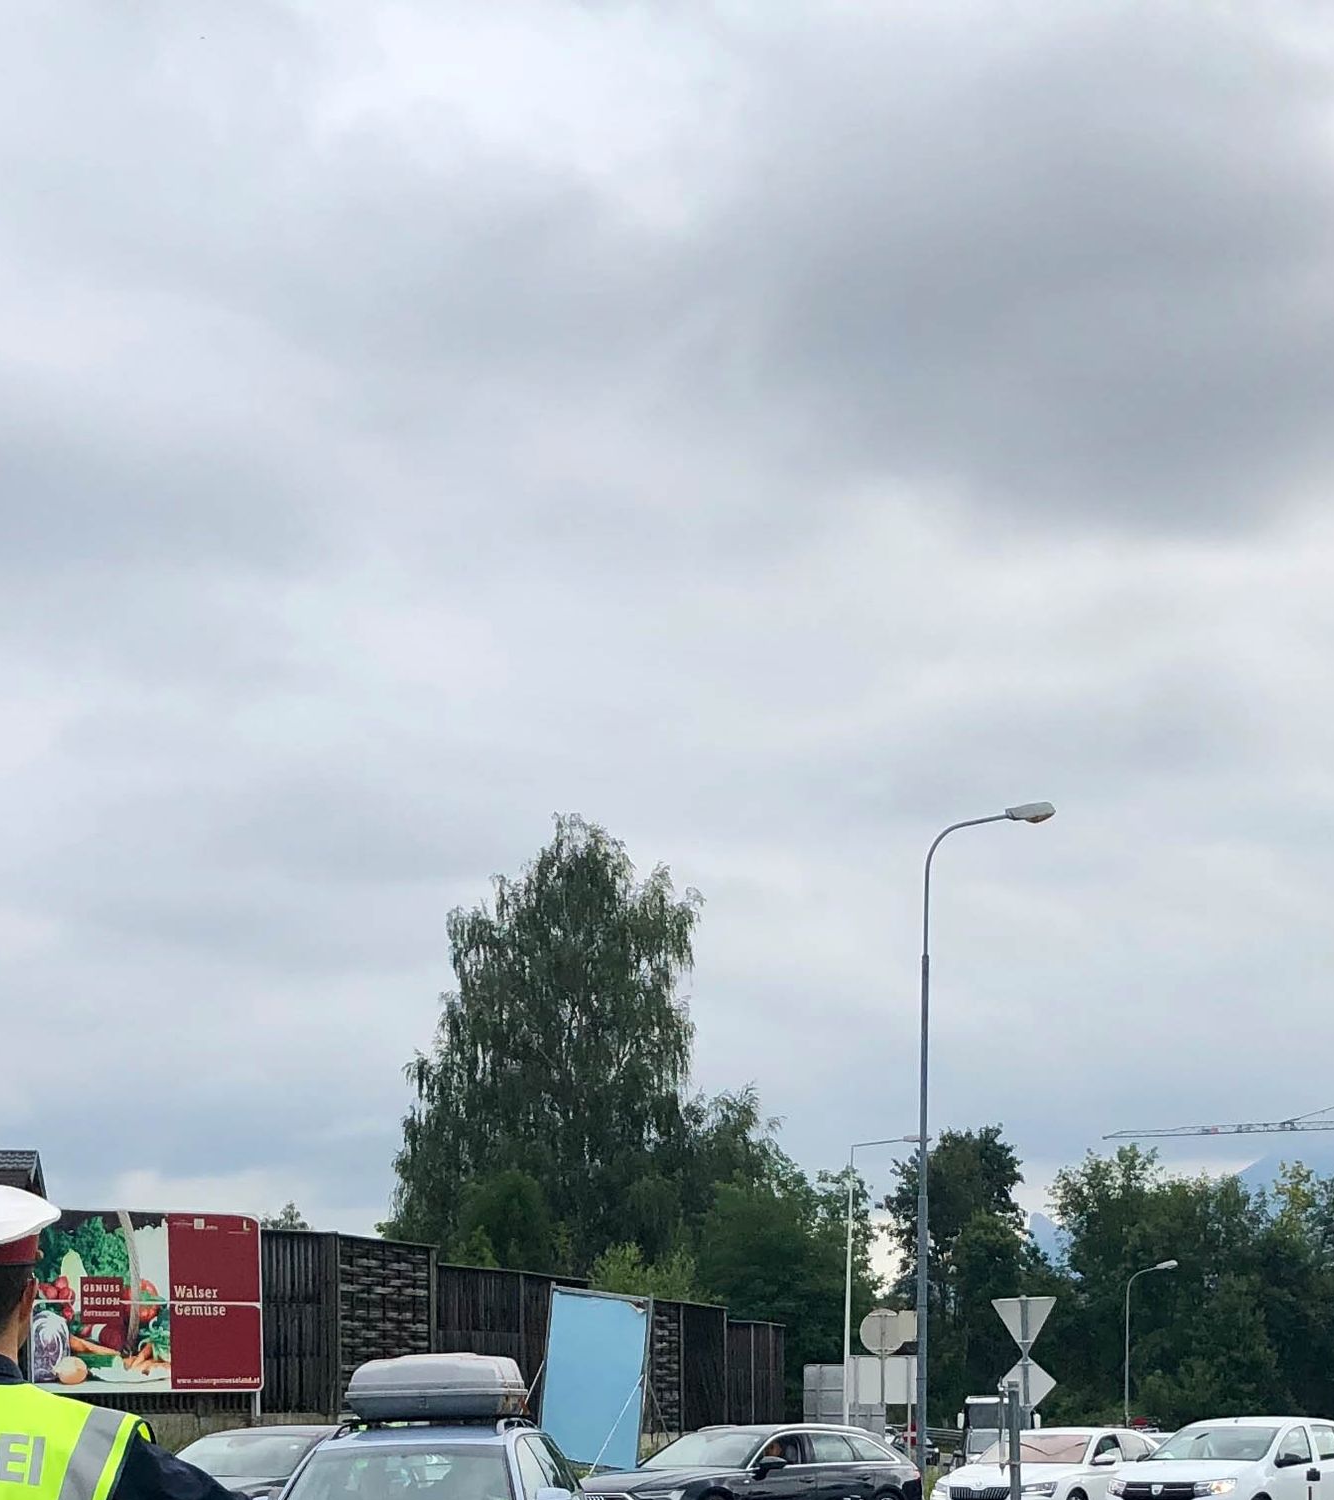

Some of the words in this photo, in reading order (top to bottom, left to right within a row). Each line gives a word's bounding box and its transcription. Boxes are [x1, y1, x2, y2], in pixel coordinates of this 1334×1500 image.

[83, 1283, 120, 1293] GENUSS
[173, 1285, 218, 1299] Walser
[83, 1296, 120, 1306] REGION
